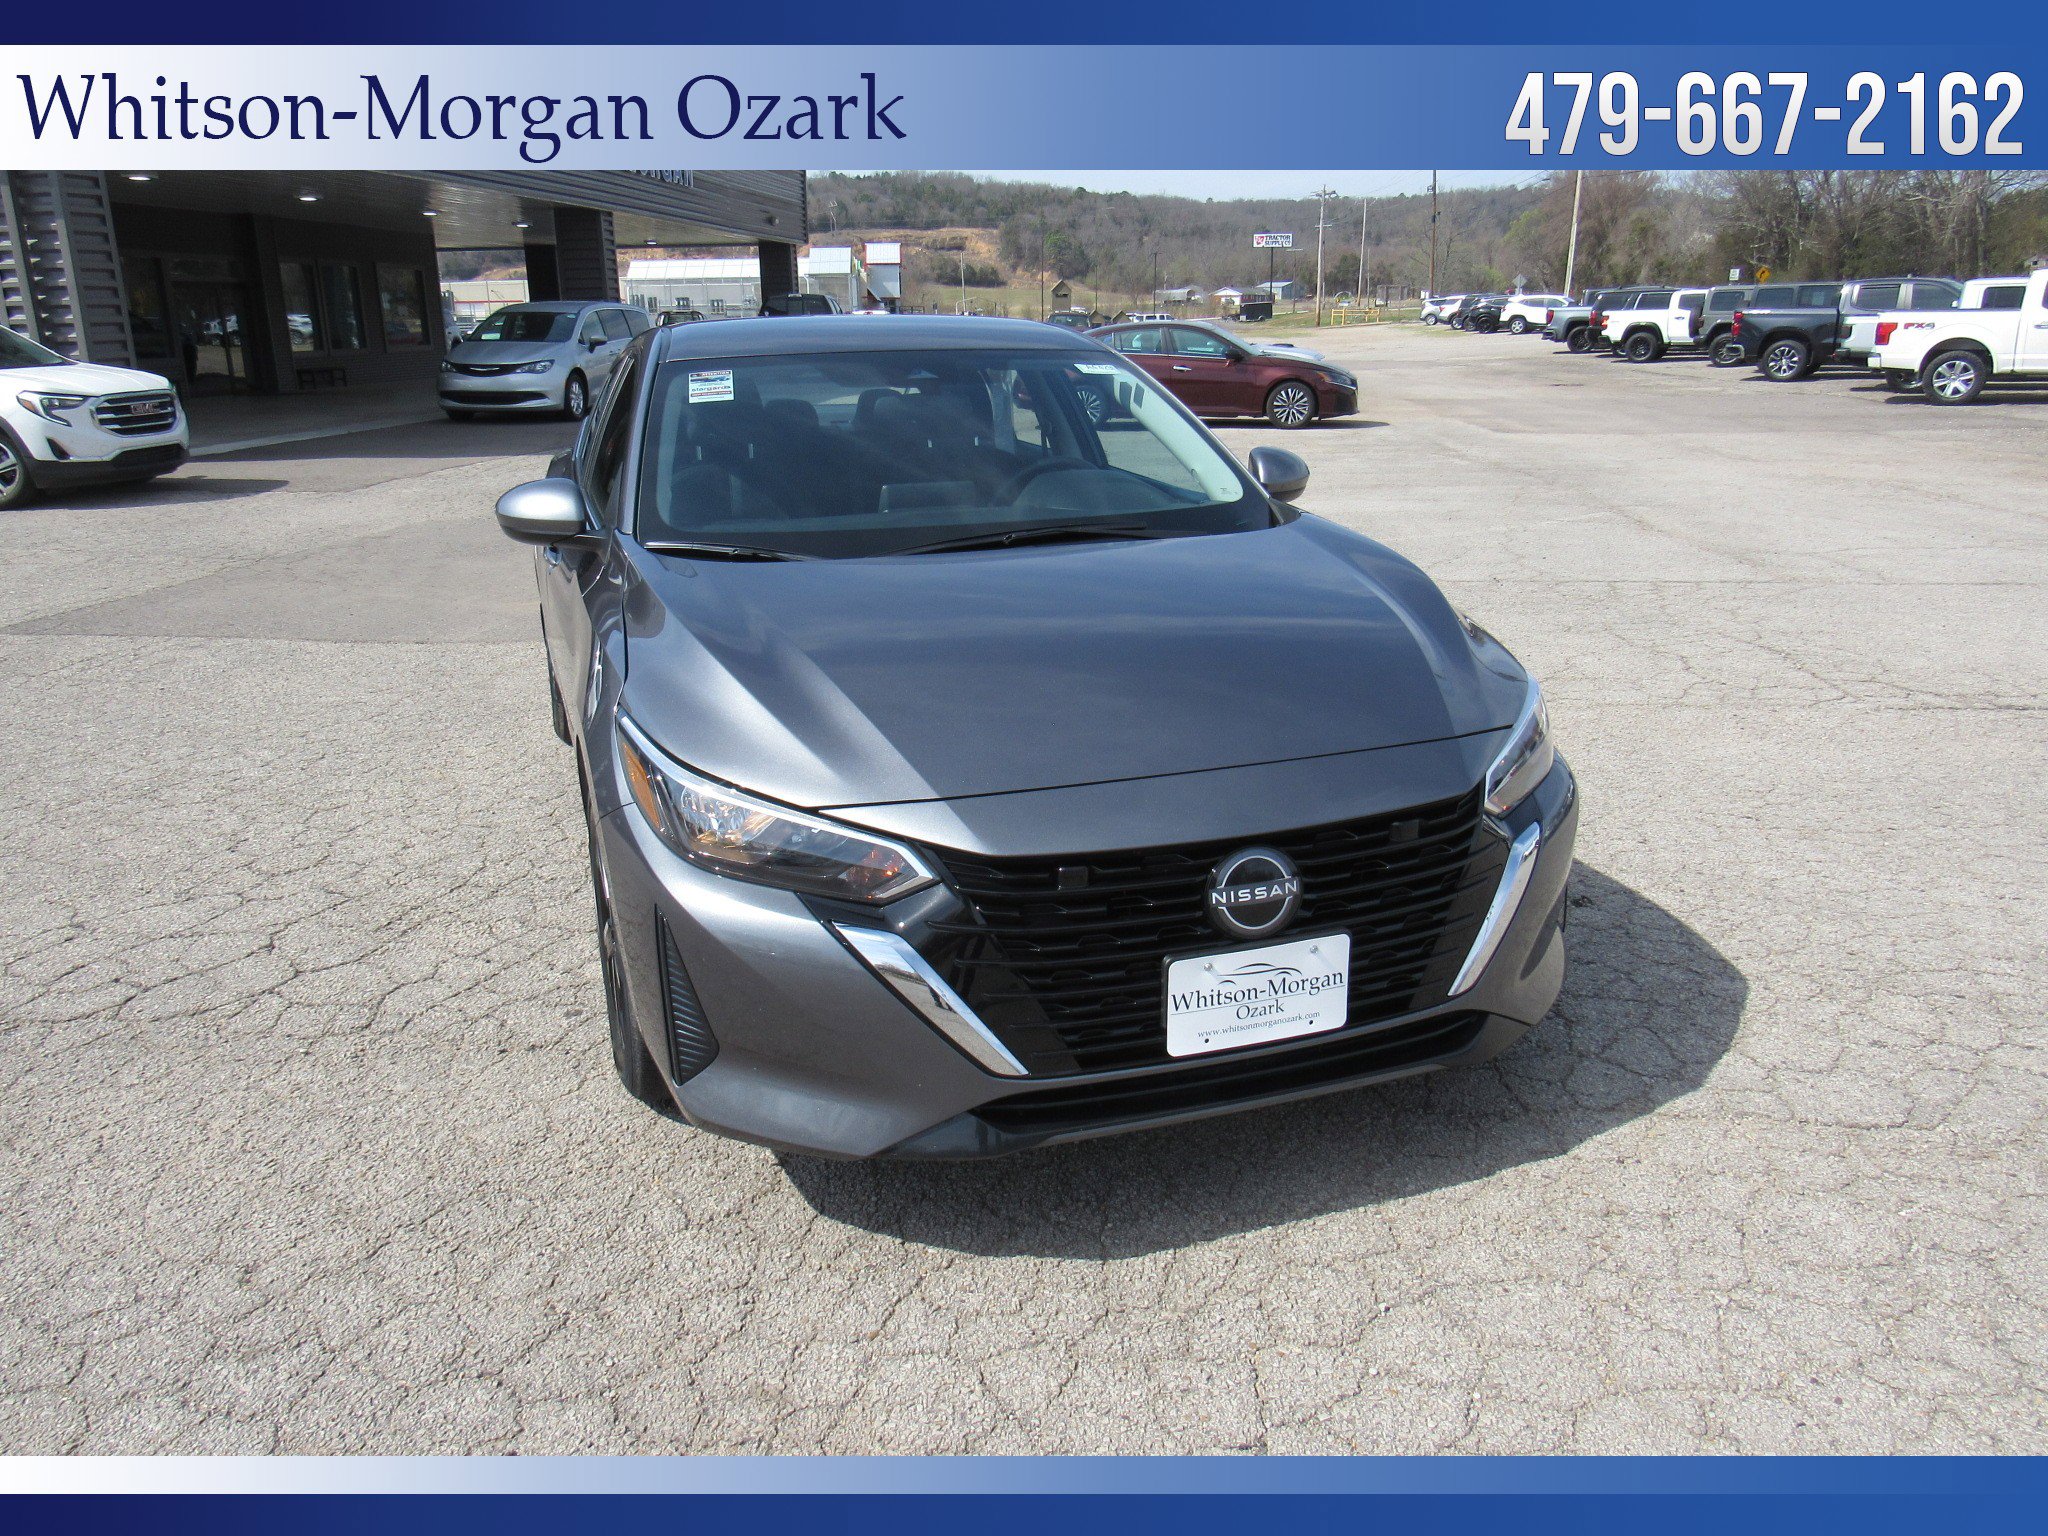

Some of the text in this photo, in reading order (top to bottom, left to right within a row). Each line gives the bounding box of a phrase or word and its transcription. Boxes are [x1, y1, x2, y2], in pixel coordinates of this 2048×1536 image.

[131, 402, 160, 414] GMC
[1211, 880, 1298, 904] NISSAN
[1171, 971, 1344, 1012] Whitson-Morgan
[1236, 999, 1285, 1020] Ozark
[1198, 1011, 1321, 1038] www.whitsonmorganozark.com
